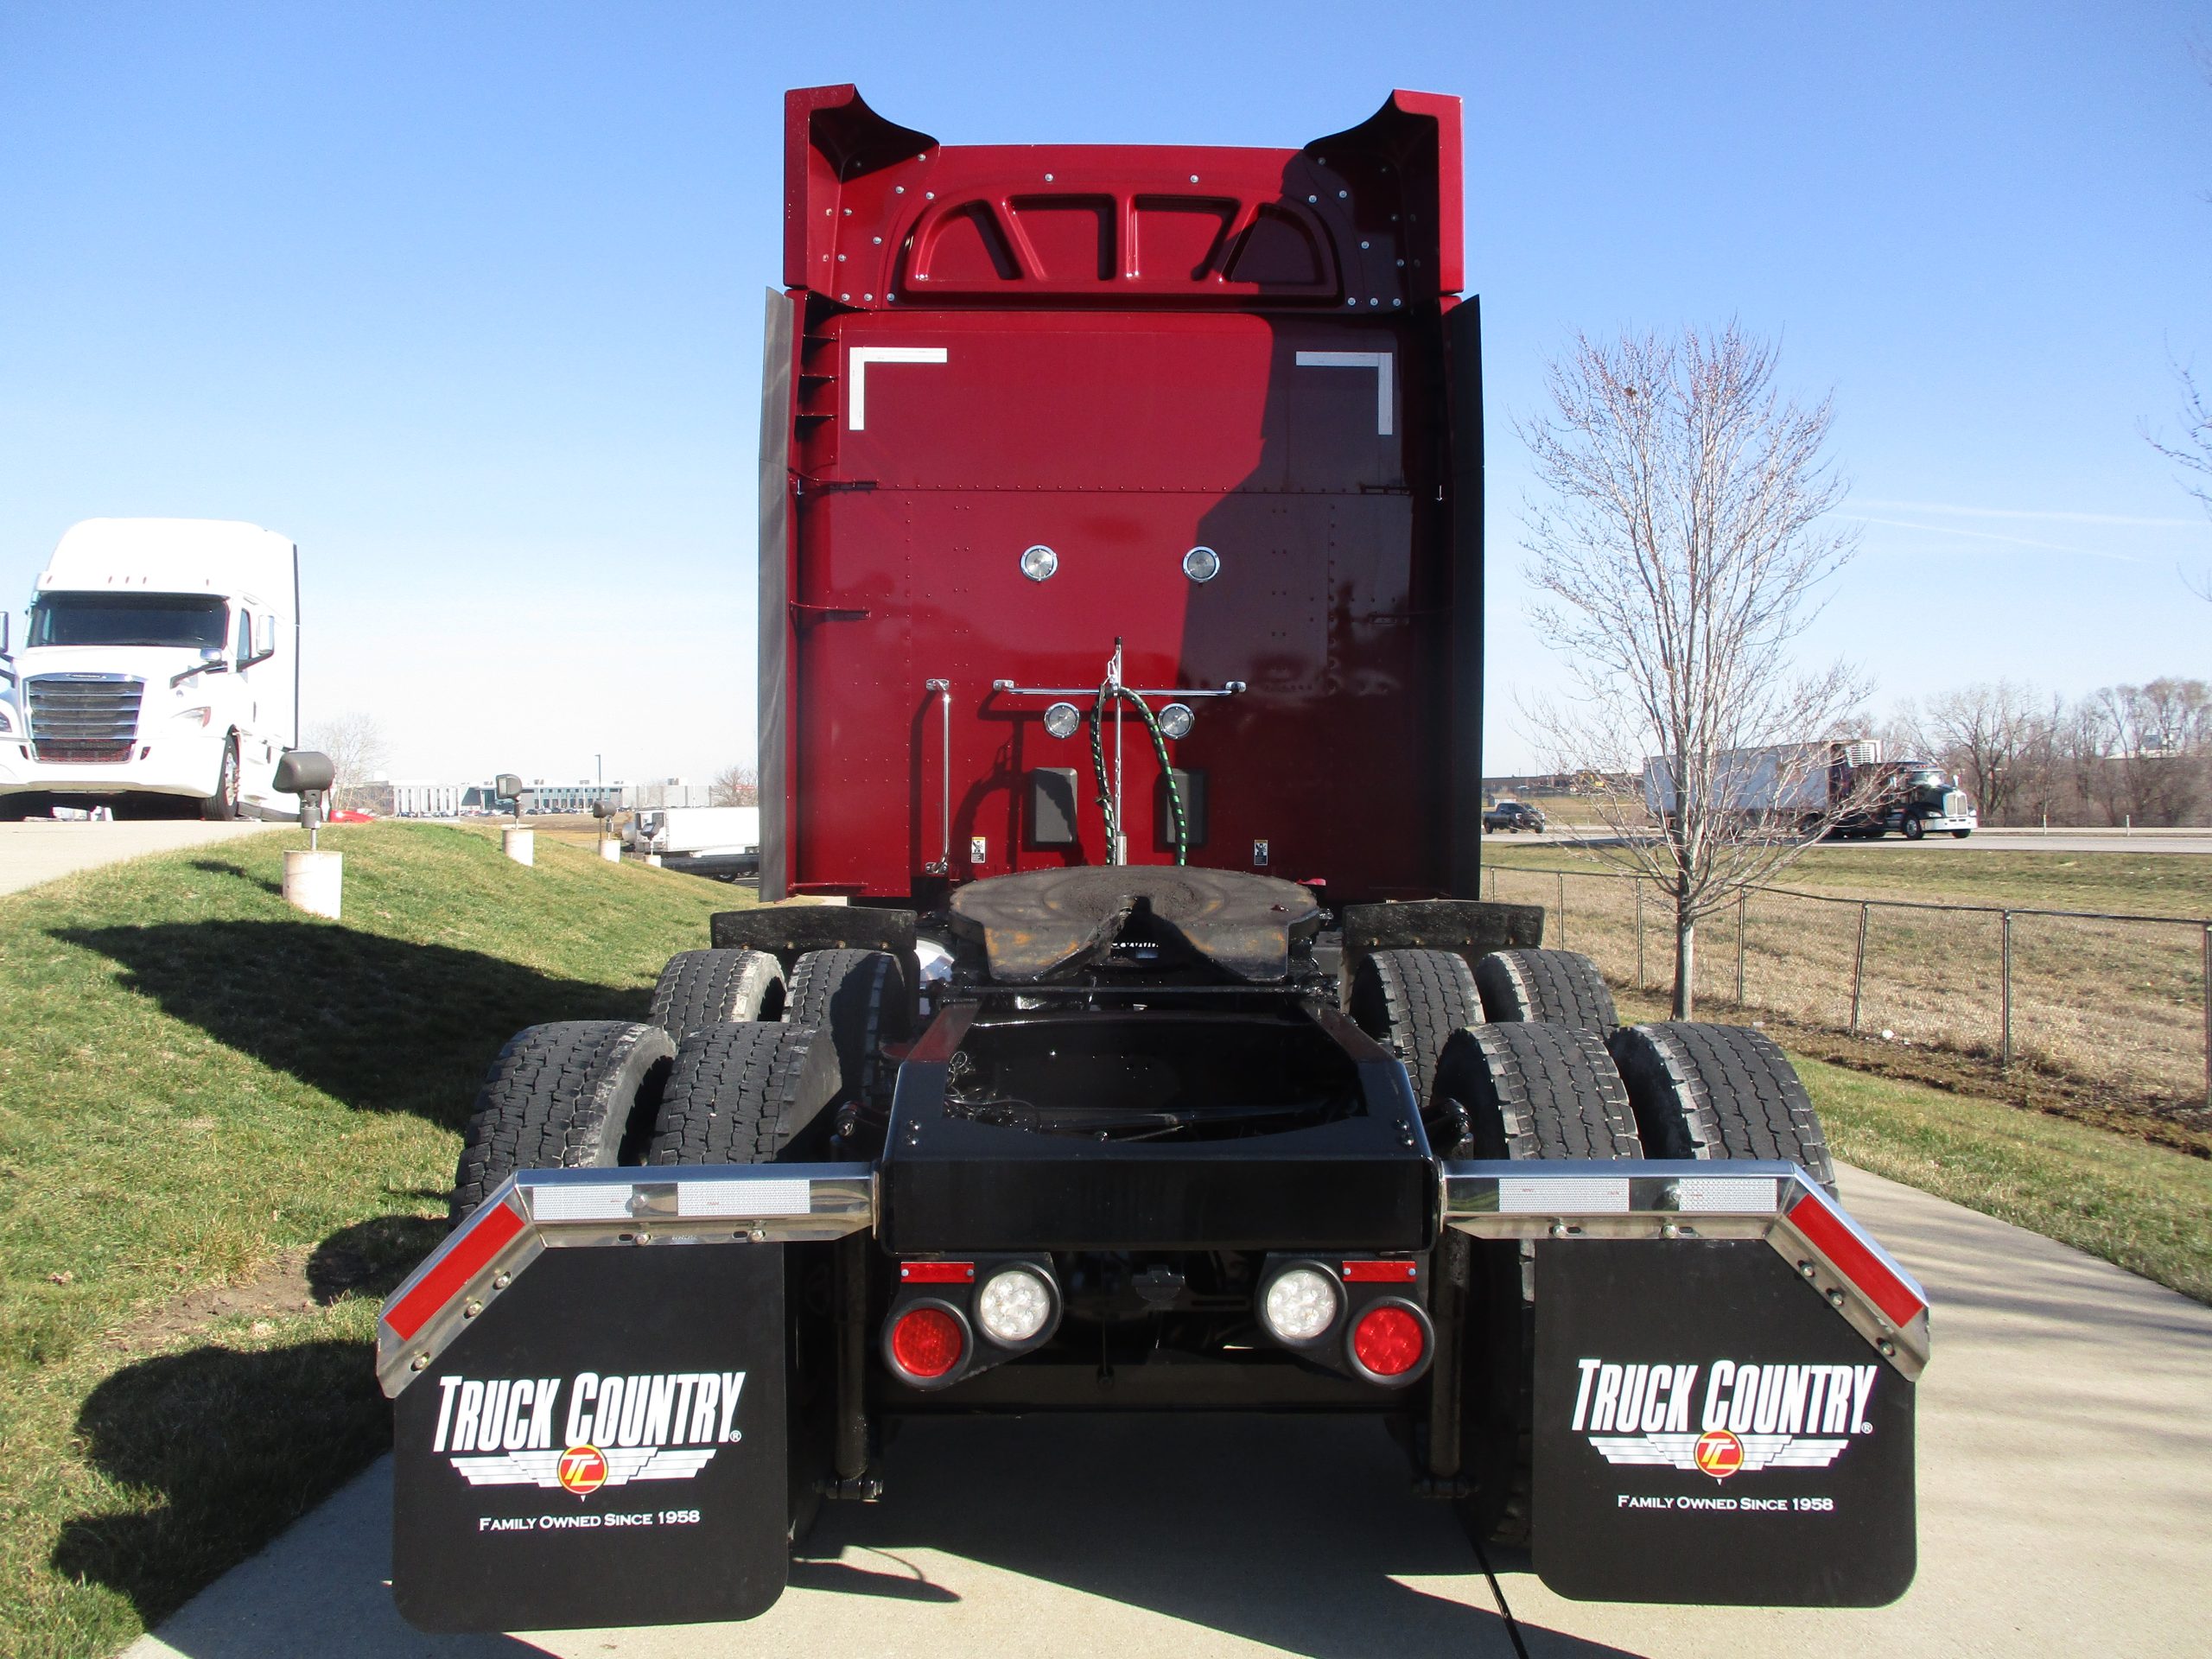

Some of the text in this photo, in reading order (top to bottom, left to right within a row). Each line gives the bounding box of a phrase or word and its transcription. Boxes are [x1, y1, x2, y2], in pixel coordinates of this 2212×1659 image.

[434, 1376, 562, 1452] TRUCK
[1572, 1359, 1699, 1432] TRUCK
[479, 1510, 701, 1532] FAMILY OWNED SINCE 1958
[1618, 1494, 1834, 1511] FAMILY OWNED SINCE 1958
